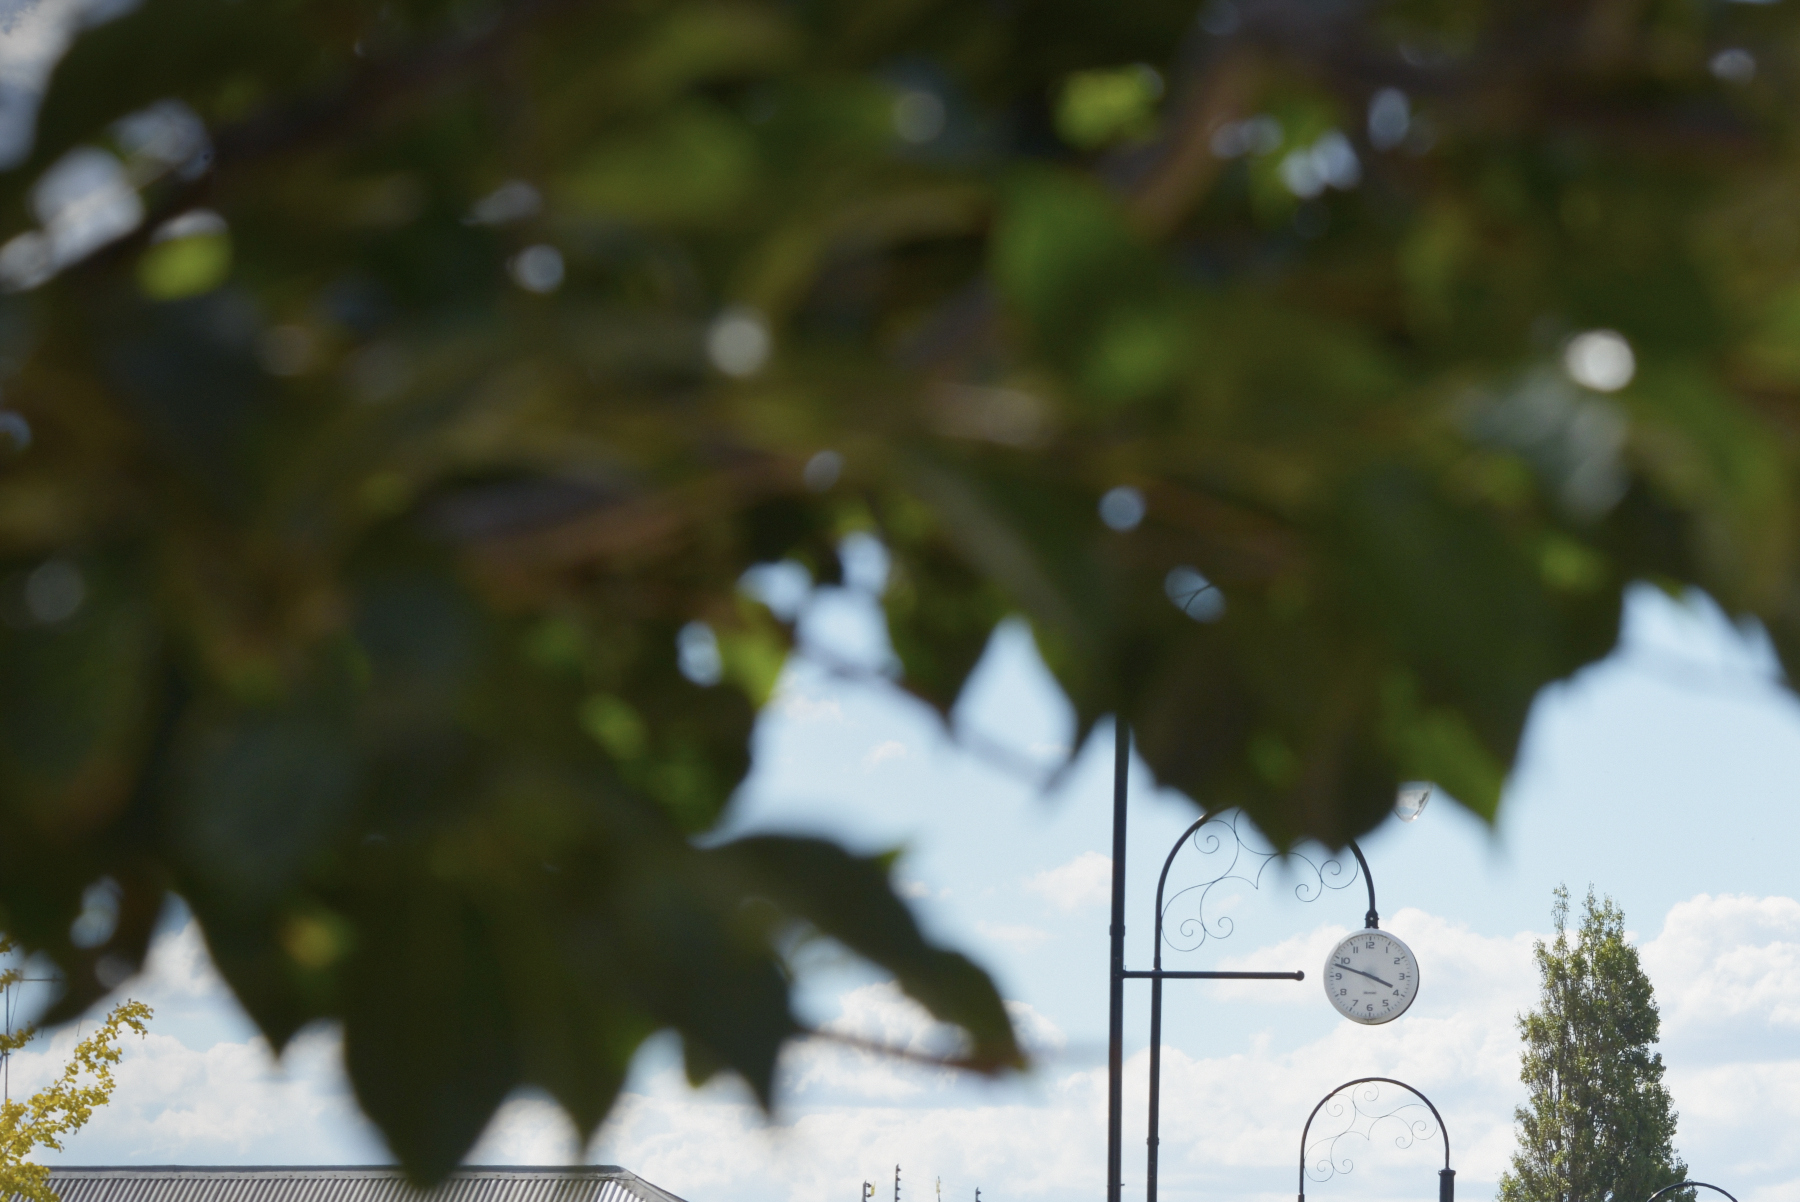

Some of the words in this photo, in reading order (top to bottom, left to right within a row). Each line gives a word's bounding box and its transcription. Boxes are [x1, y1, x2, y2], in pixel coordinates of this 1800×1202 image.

[1352, 946, 1358, 954] 11
[1366, 942, 1376, 950] 12
[1335, 972, 1342, 980] 9
[1398, 972, 1406, 980] 3
[1340, 988, 1347, 996] 8
[1382, 999, 1389, 1007] 5
[1366, 1004, 1374, 1012] 6
